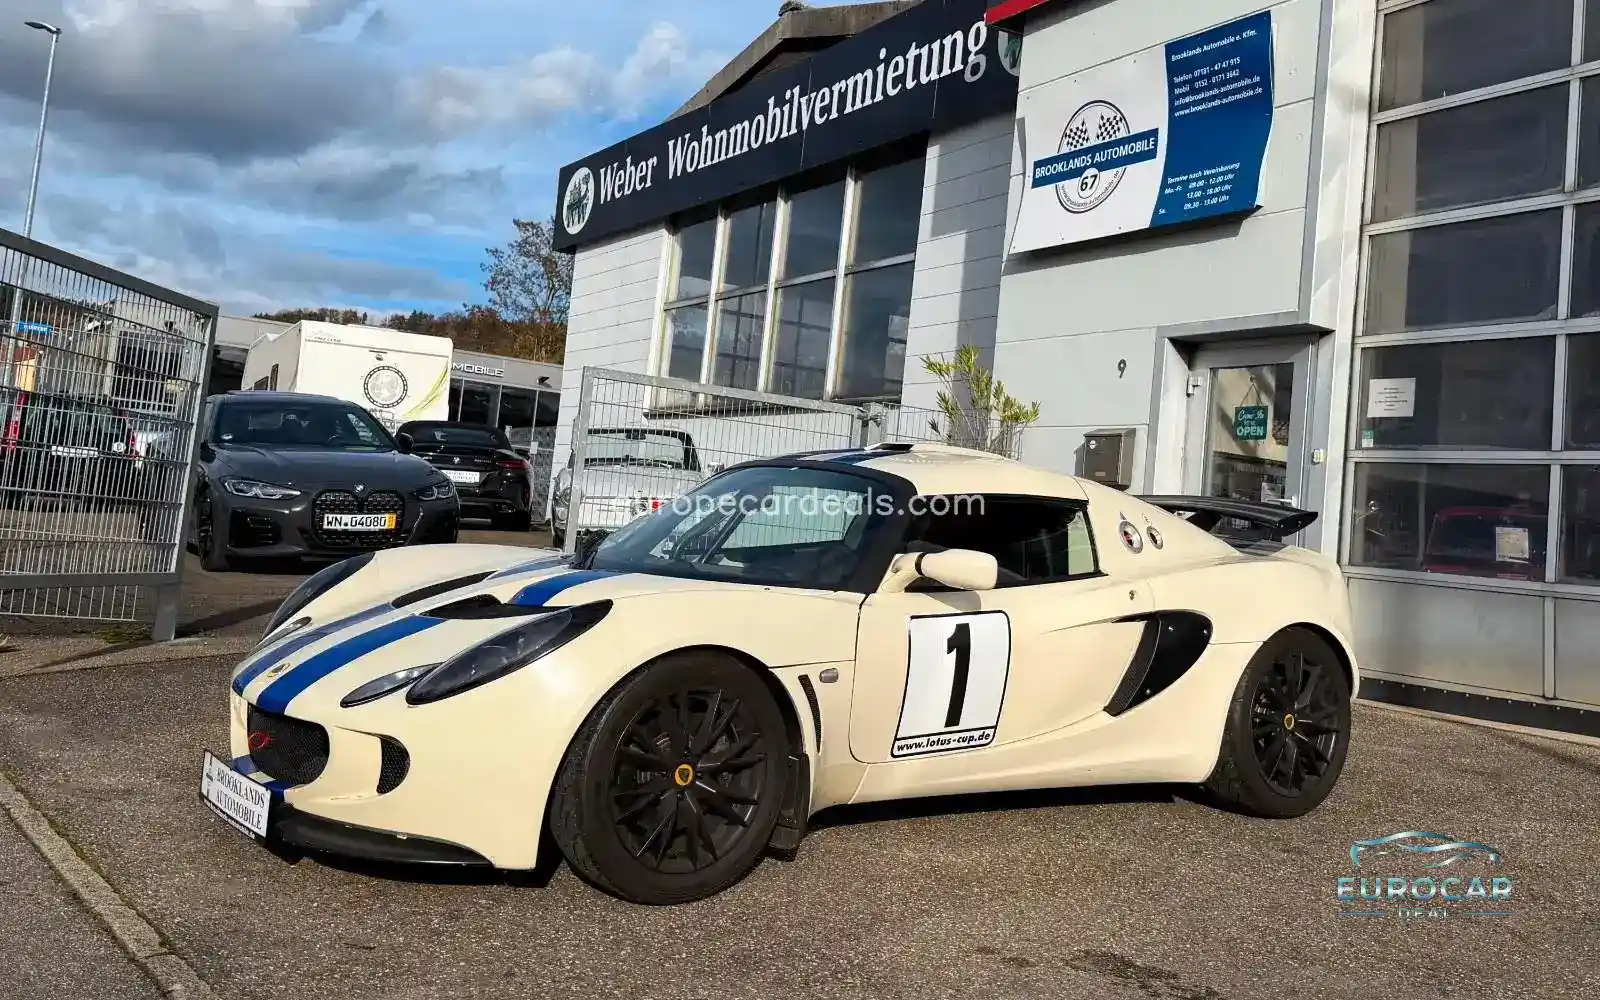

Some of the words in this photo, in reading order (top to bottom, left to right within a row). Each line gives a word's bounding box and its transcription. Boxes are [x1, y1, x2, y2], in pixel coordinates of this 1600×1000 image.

[1171, 47, 1202, 62] Brooklands
[1202, 36, 1235, 52] Automobile
[1242, 29, 1258, 39] Kfm.
[1173, 73, 1193, 84] Telefon
[1214, 62, 1221, 71] 47
[1221, 60, 1229, 69] 47
[1229, 56, 1241, 67] 915
[1174, 84, 1190, 95] Mobil
[1194, 78, 1209, 89] 0152
[599, 154, 659, 206] Weber
[667, 19, 988, 180] Wohnmobilvermietung
[1174, 86, 1263, 117] www.brooklands-automobile.de
[1034, 154, 1092, 179] BROOKLANDS
[1093, 137, 1155, 167] AUTOMOBILE
[1080, 173, 1098, 191] 67
[1188, 170, 1202, 179] nach
[450, 362, 505, 379] MOBILE
[1117, 358, 1127, 379] 9
[1236, 425, 1264, 436] OPEN
[326, 515, 343, 527] WN
[350, 516, 387, 527] 04080
[943, 622, 971, 728] 1
[896, 731, 991, 752] www.lotus-cup.de
[216, 767, 265, 809] BROOKLANDS
[216, 788, 263, 830] AUTOMOBILE
